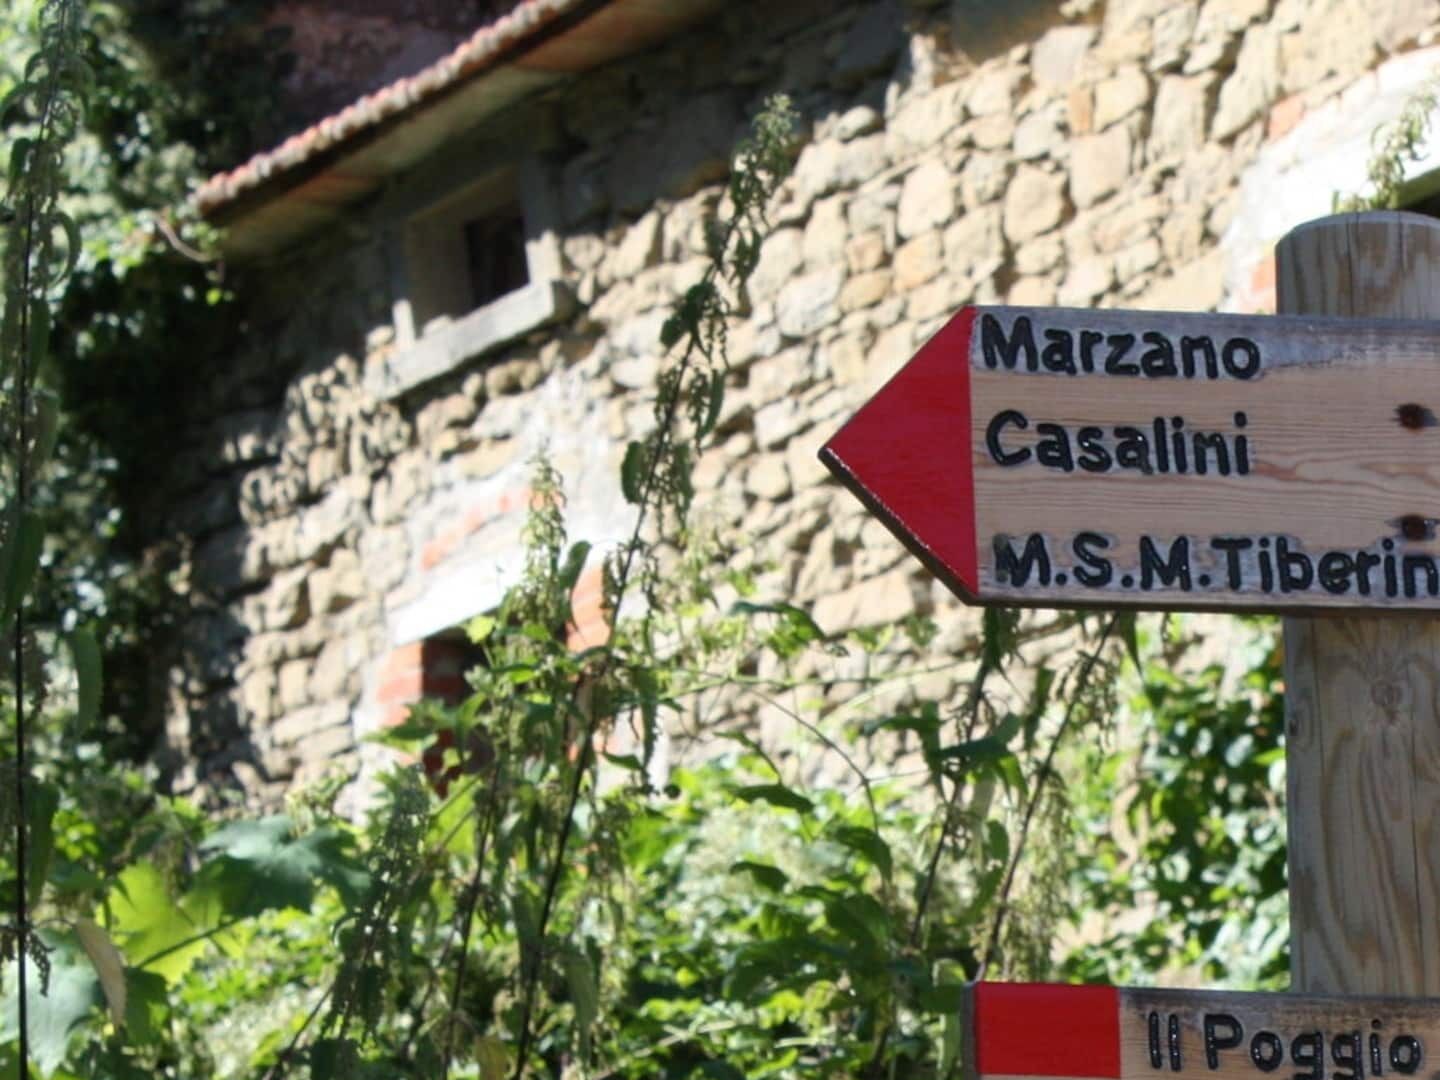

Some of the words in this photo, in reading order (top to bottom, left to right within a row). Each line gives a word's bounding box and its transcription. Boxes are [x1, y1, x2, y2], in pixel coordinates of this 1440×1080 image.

[980, 313, 1261, 381] Marzano
[985, 409, 1251, 476] Casalini
[1148, 1010, 1181, 1071] Il
